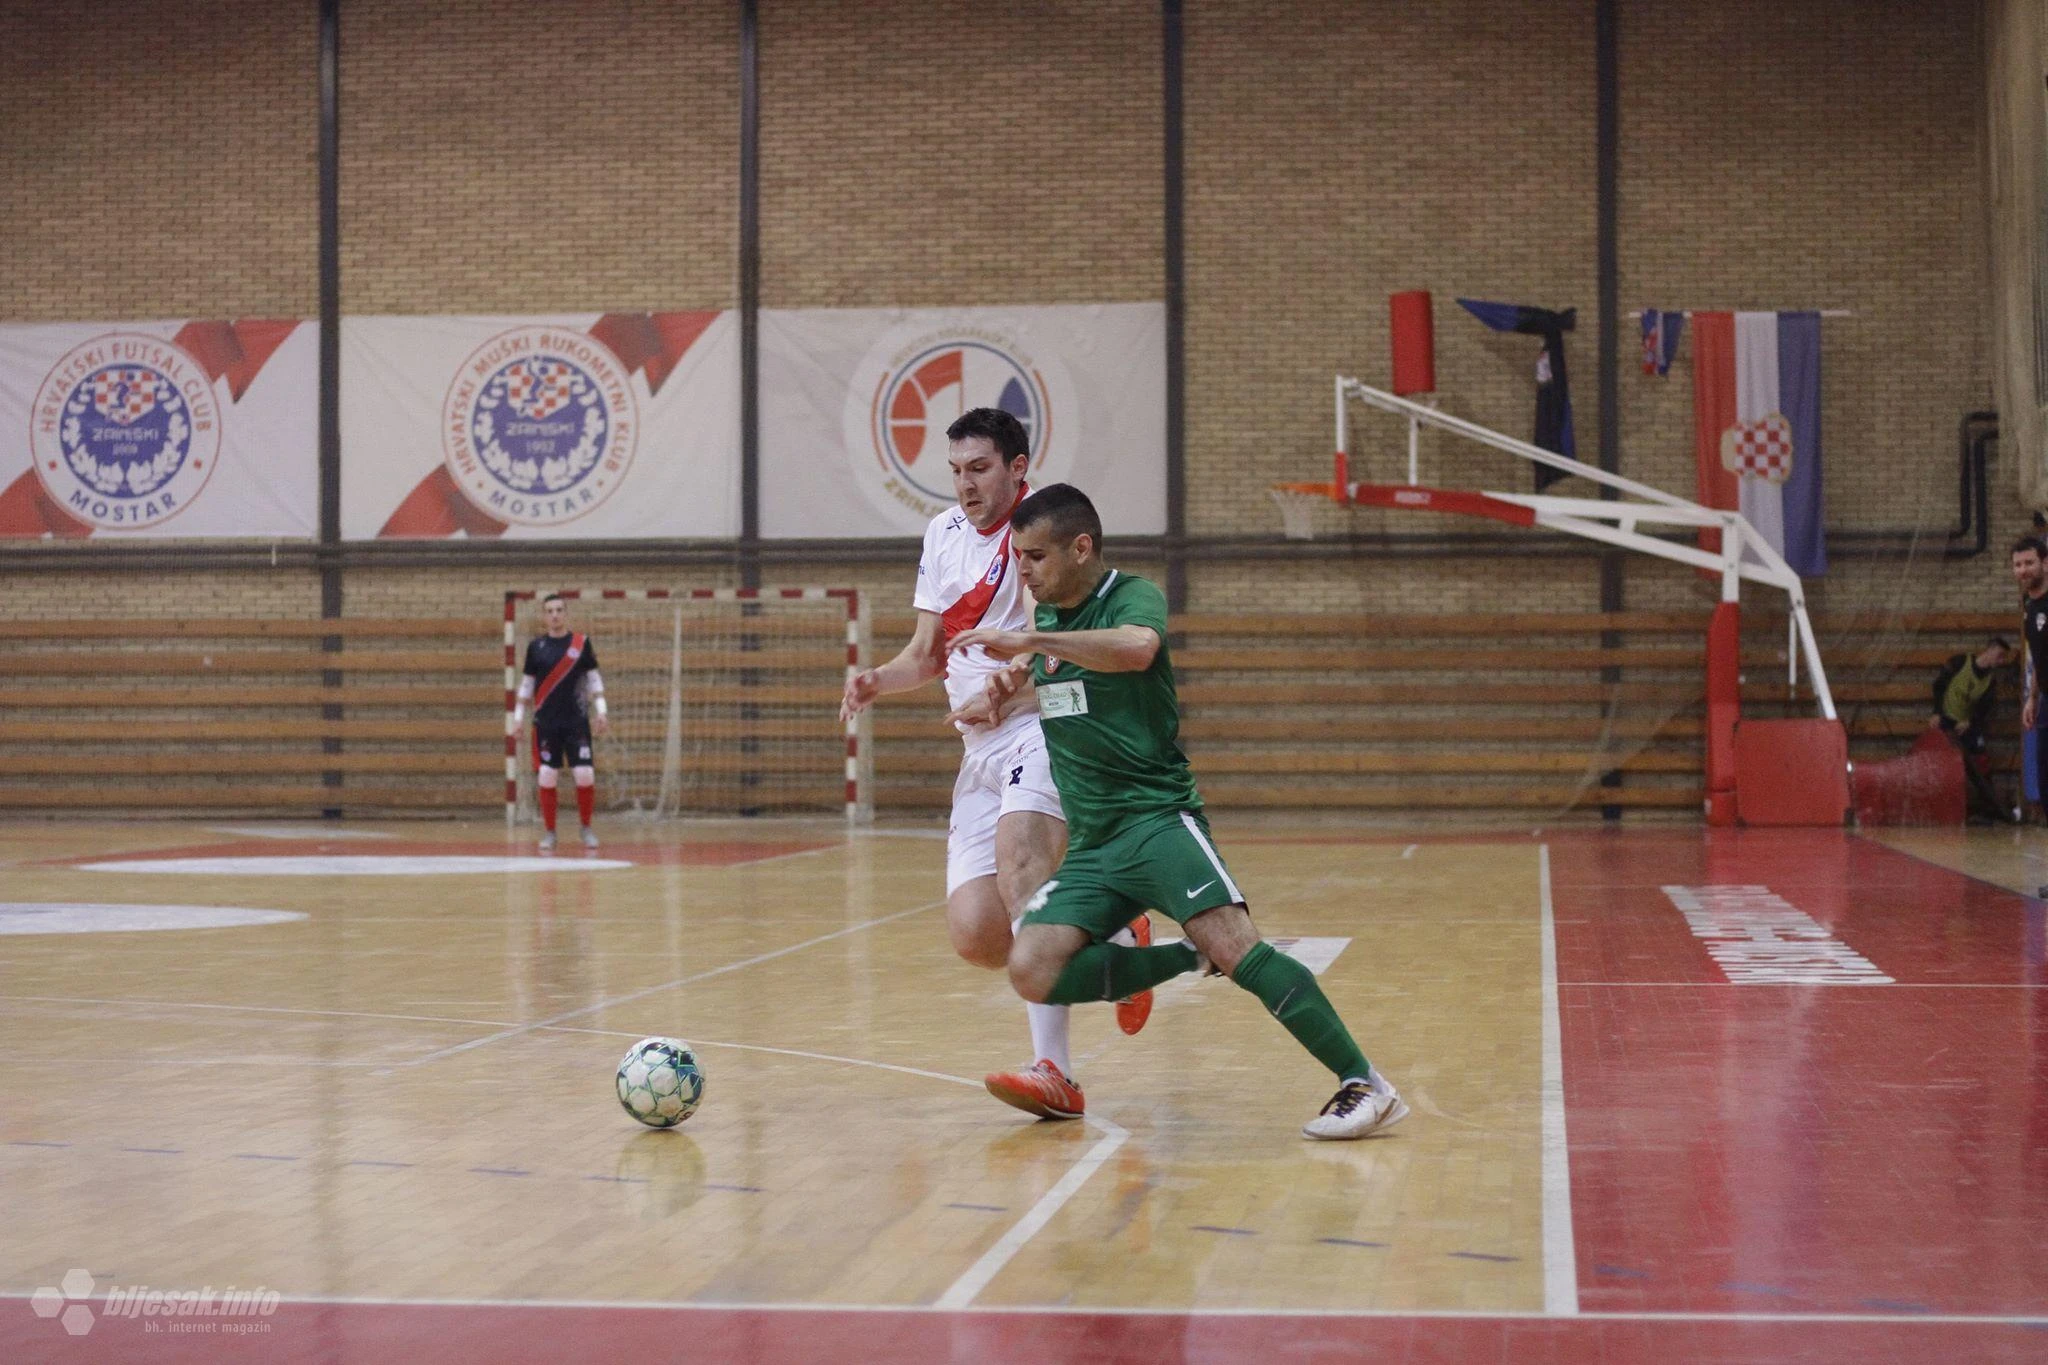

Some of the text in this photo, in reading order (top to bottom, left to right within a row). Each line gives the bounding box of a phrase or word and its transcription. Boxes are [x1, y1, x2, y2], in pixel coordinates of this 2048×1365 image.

[41, 342, 212, 433] HRVATSKI FUTSAL CLUB
[448, 381, 475, 475] HRVATSKI
[540, 335, 628, 414] RUKOMETNI
[606, 420, 630, 473] KLUB
[70, 490, 177, 522] MOSTAR
[489, 490, 594, 517] MOSTAR
